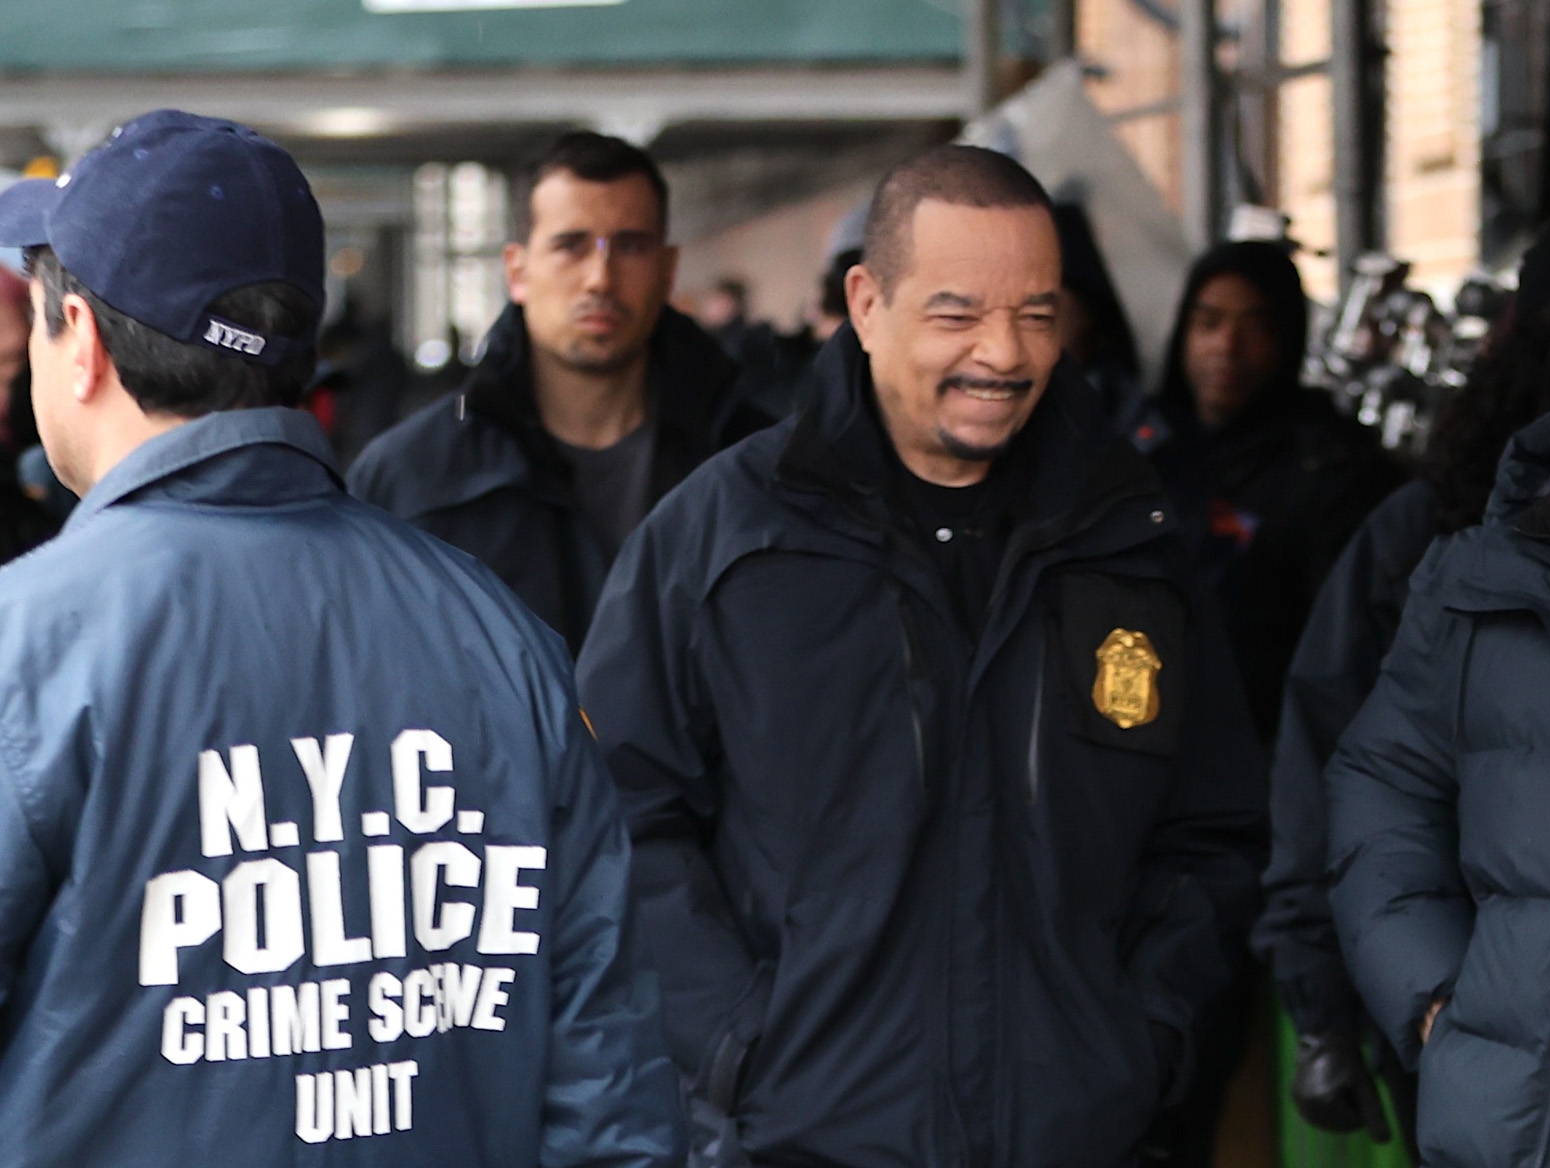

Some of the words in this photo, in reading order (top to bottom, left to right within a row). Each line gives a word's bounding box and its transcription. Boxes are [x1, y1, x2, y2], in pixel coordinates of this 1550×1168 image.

[203, 318, 267, 355] NYPD
[198, 728, 485, 858] N.Y.C.
[139, 840, 547, 986] POLICE
[161, 977, 352, 1065] CRIME
[295, 1059, 419, 1145] UNIT
